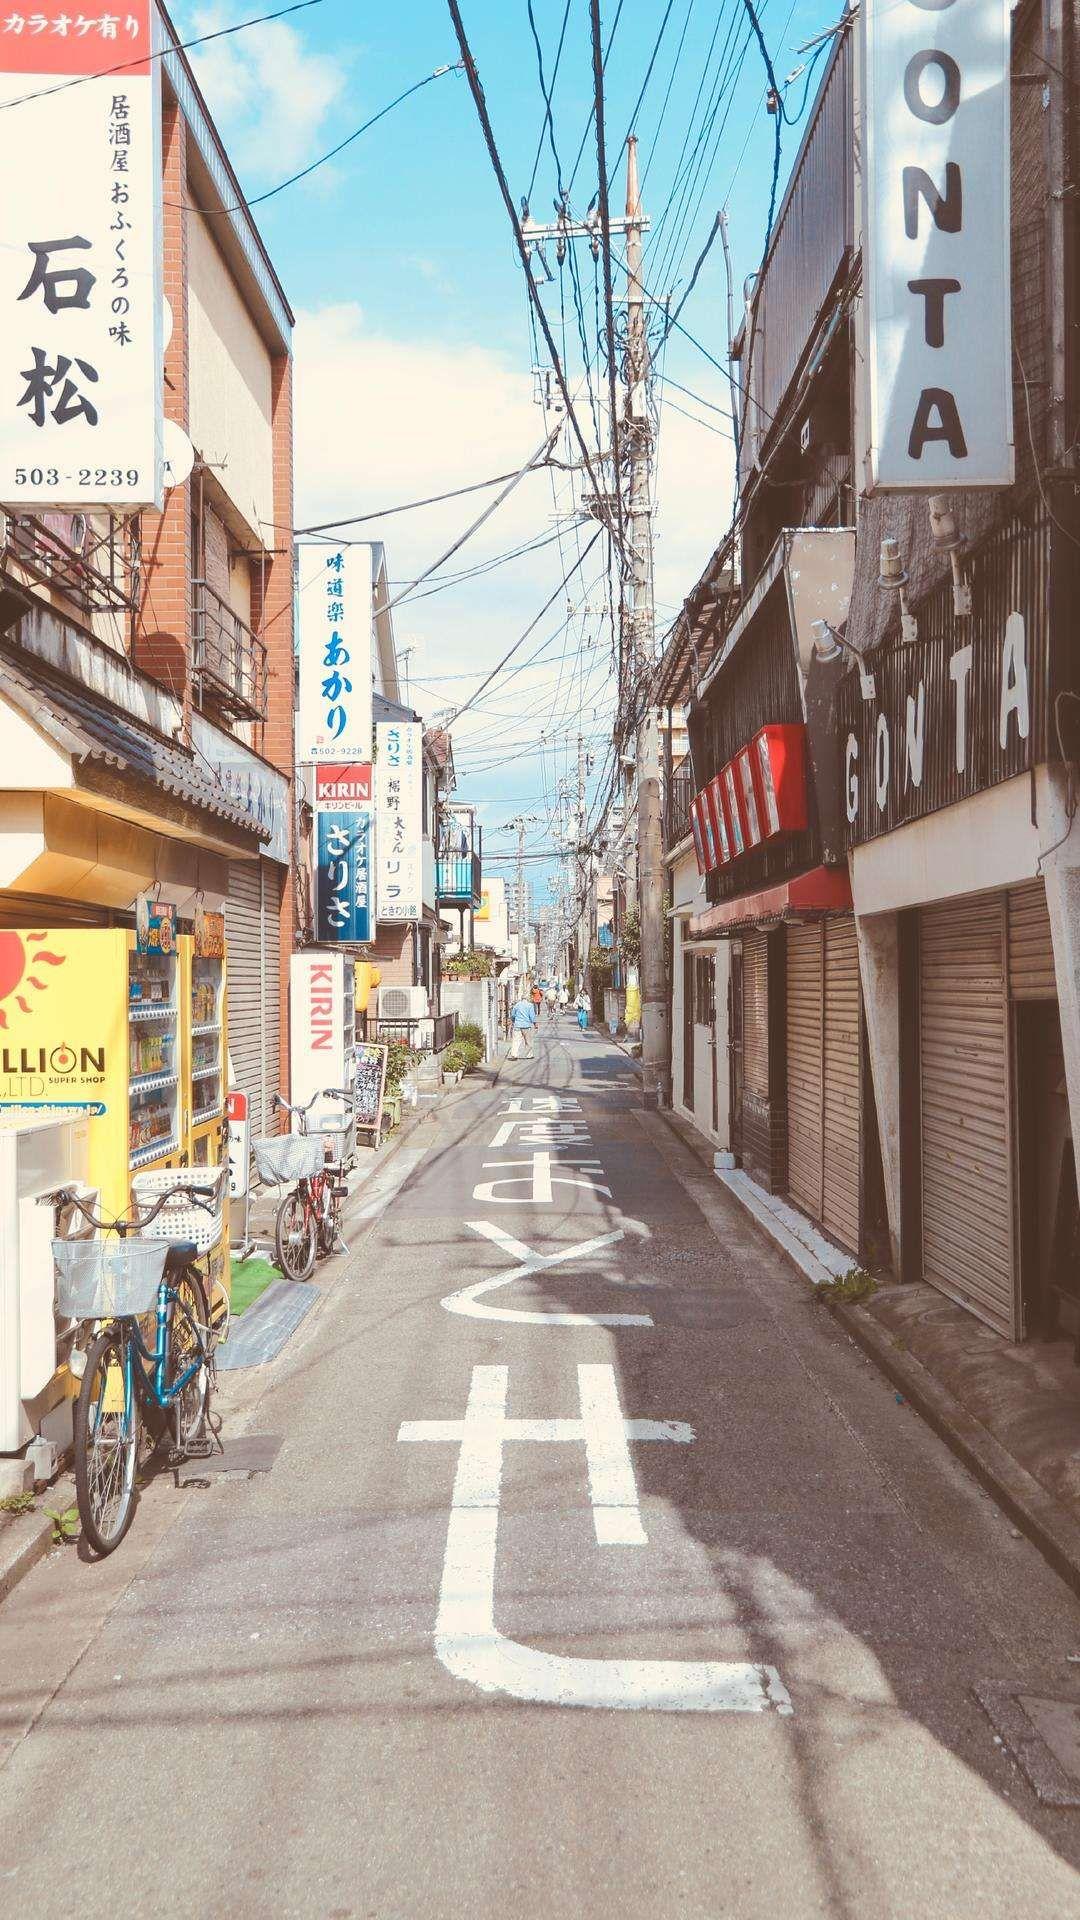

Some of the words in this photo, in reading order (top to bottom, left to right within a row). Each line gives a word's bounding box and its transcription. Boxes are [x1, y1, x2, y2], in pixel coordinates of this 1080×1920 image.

[4, 13, 140, 40] カラオケ有り
[902, 0, 968, 460] ONTA
[16, 235, 99, 428] 石松
[14, 468, 140, 487] 503-2239
[321, 631, 353, 741] あかり
[846, 611, 1030, 824] GONTA
[318, 782, 369, 798] KIRIN
[325, 801, 363, 810] キリンビール
[326, 823, 351, 928] さりさ
[354, 816, 368, 908] カラオケ居酒屋
[310, 964, 333, 1050] KIRIN
[80, 1076, 106, 1084] SHOP
